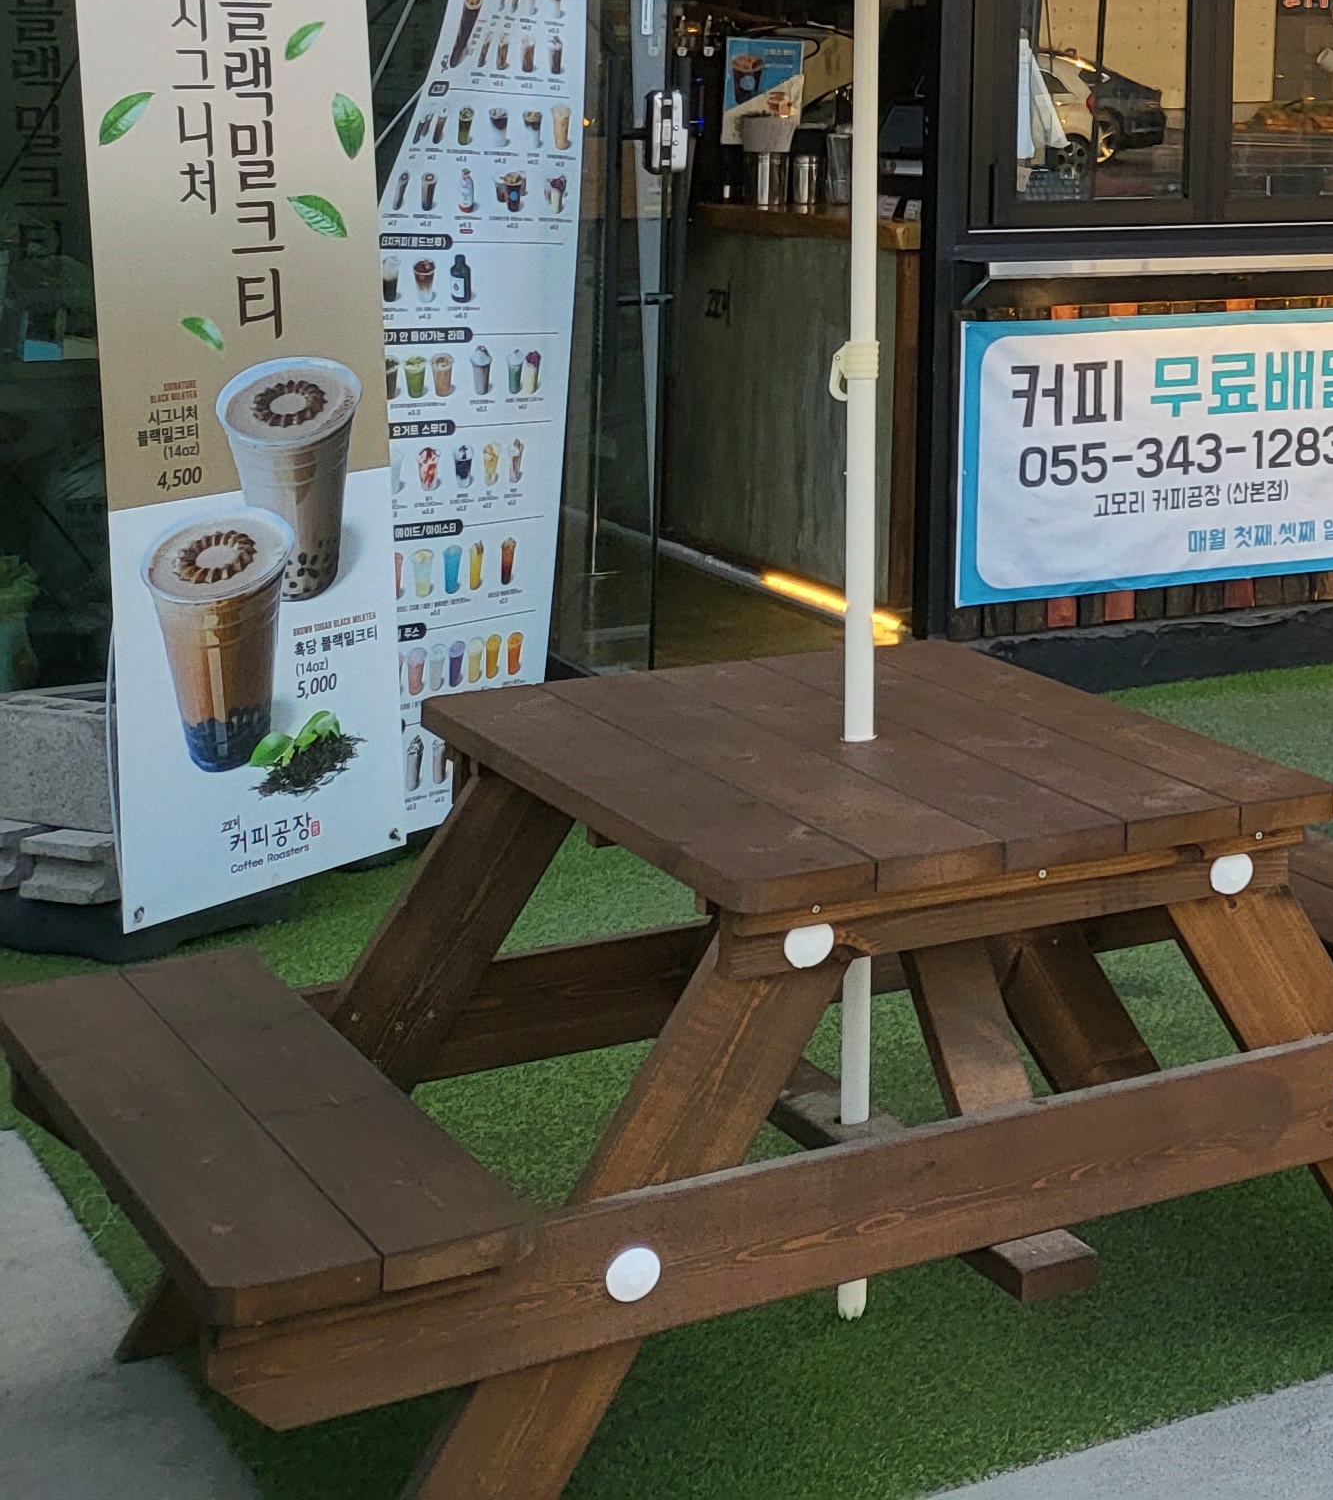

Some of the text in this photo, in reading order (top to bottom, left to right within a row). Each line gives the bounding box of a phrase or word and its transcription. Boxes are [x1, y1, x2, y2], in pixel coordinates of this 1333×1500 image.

[1010, 359, 1124, 428] 커피
[147, 404, 199, 426] 시그니처
[137, 422, 200, 448] 블랙밀크티
[393, 422, 448, 437] 요거트 스무디
[163, 442, 201, 461] (14oz)
[156, 465, 203, 490] 4,500
[1094, 479, 1290, 517] 고모리 커피공장 (산본점)
[1187, 527, 1226, 554] 매월
[294, 625, 378, 657] 흑당 블랙밀크티
[404, 627, 420, 639] 주스
[296, 656, 329, 678] (14oz)
[296, 672, 338, 700] 5,000
[229, 811, 312, 854] 커피공장
[231, 843, 310, 874] Coffee Roasters
